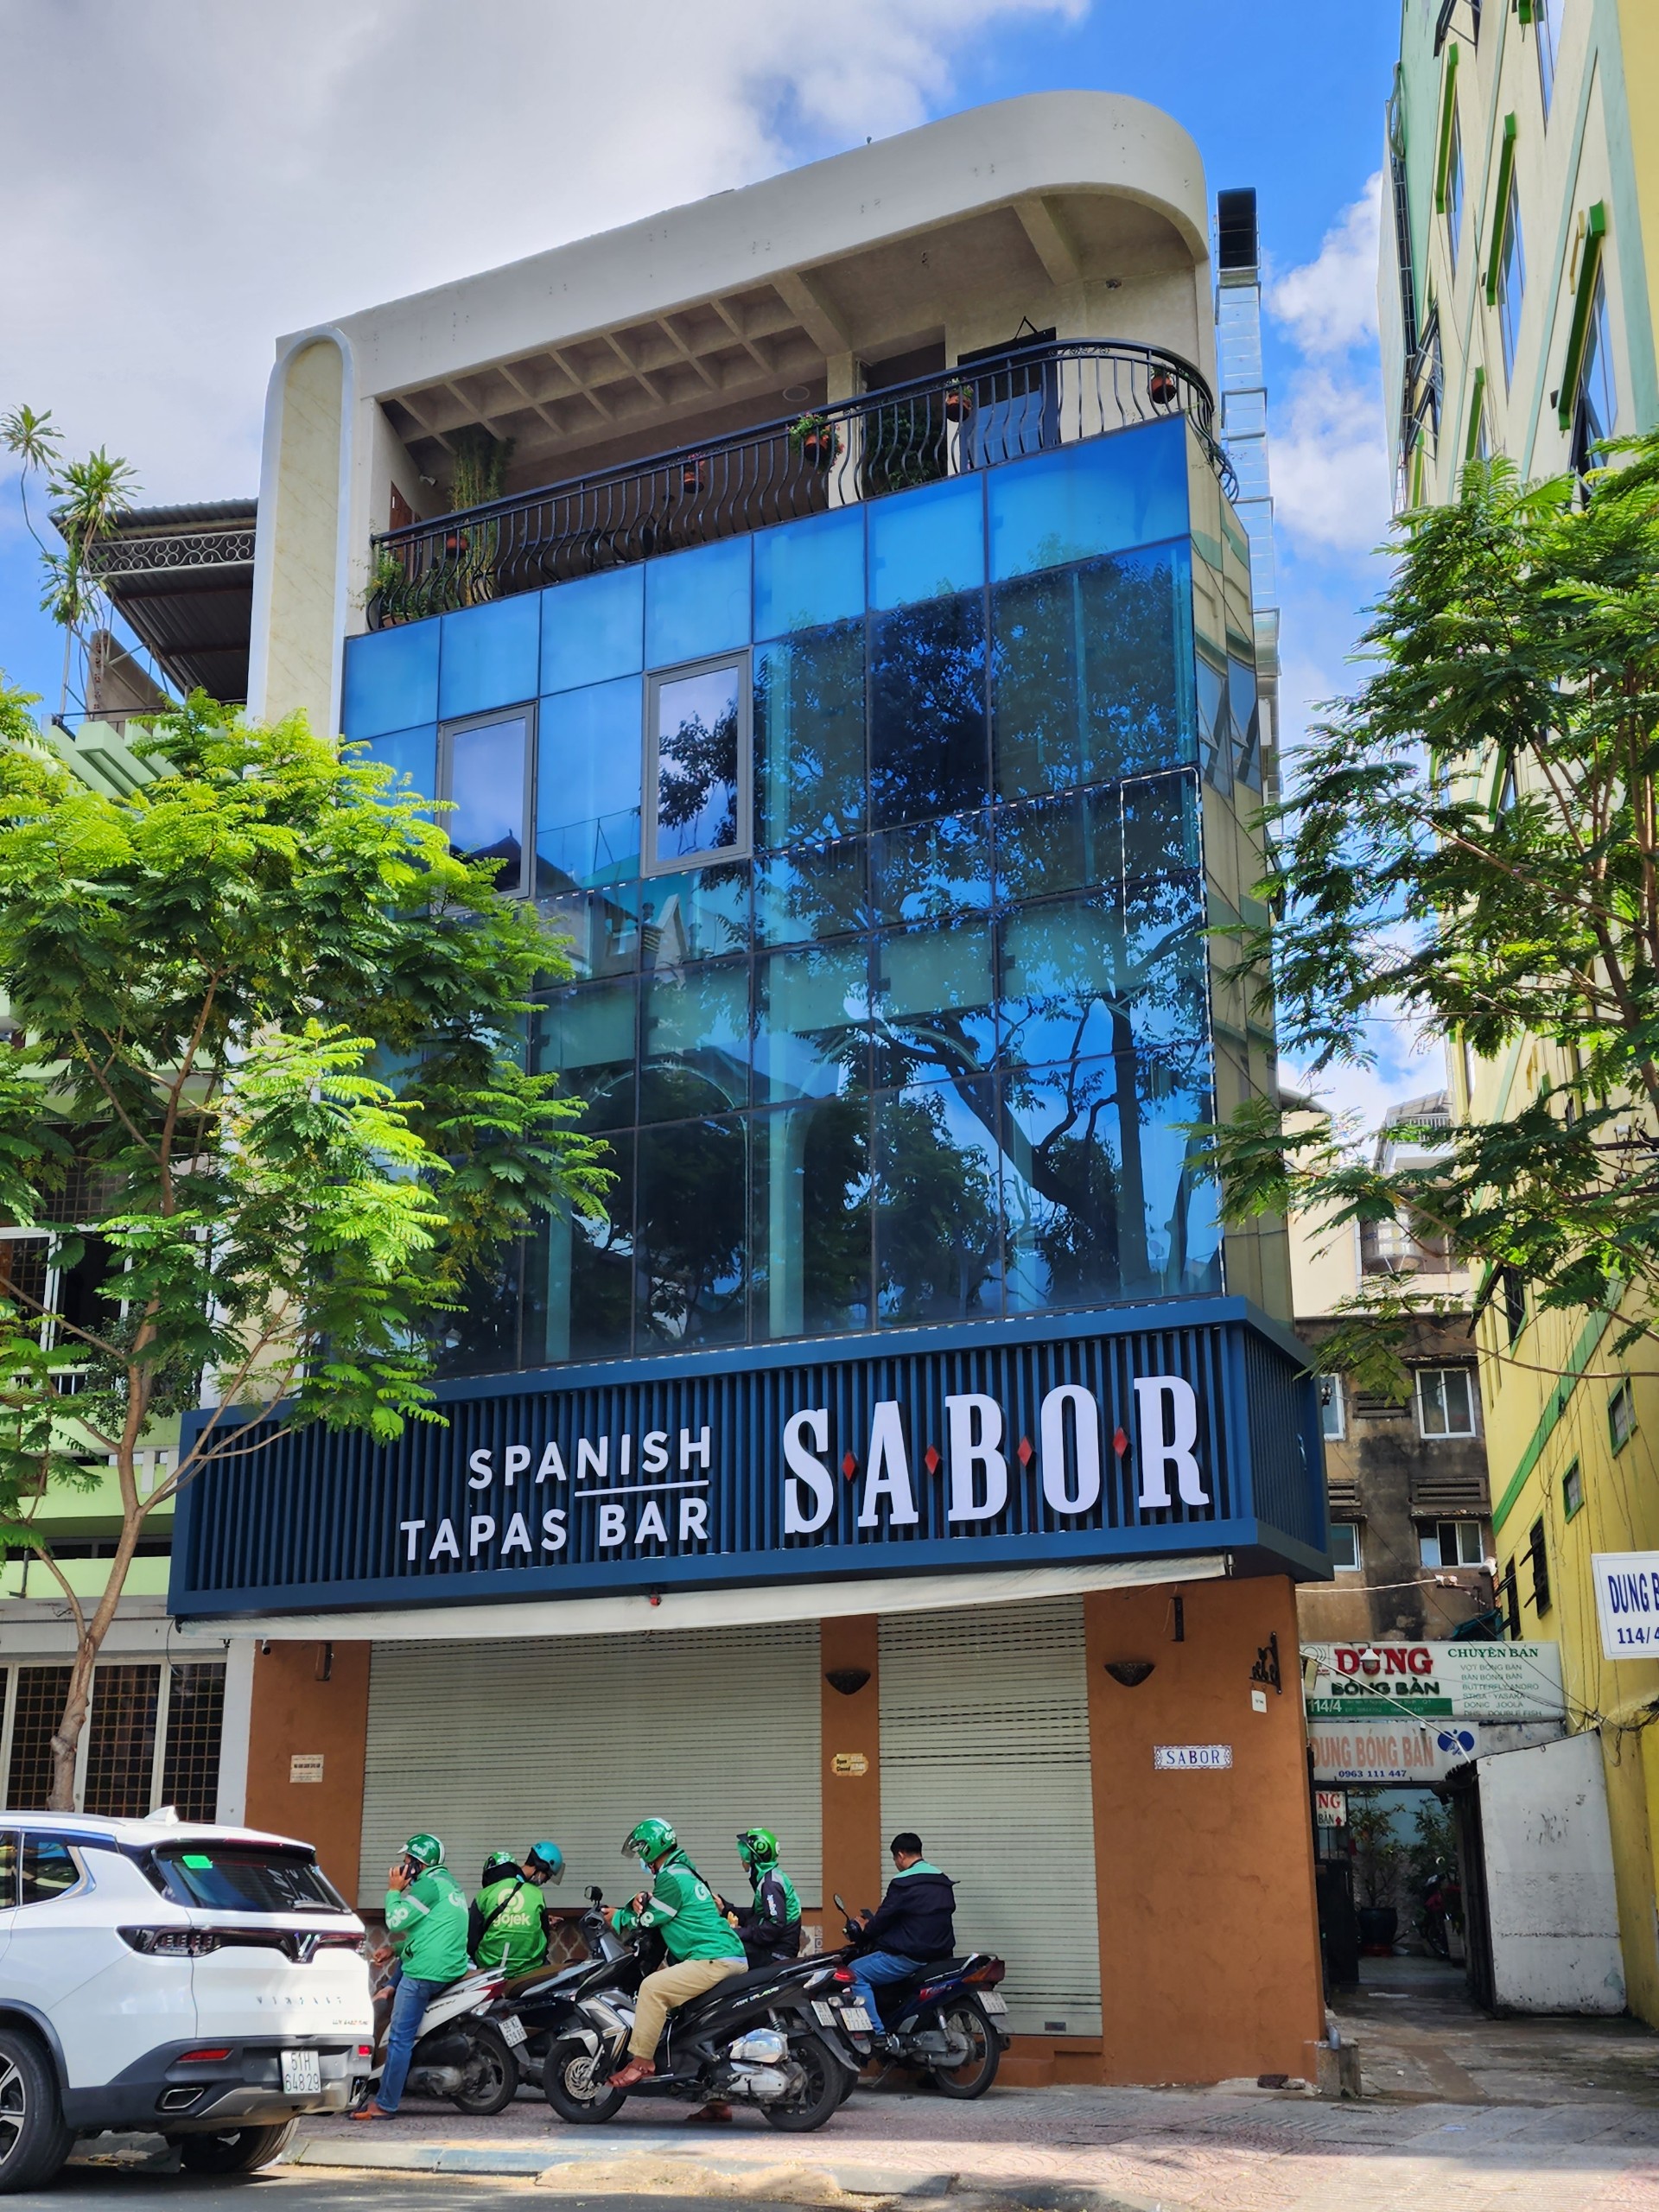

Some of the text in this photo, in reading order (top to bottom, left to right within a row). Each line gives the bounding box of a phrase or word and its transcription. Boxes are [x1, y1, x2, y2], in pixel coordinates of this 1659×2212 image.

[467, 1426, 711, 1491] SPANISH
[781, 1375, 1210, 1535] SABOR
[400, 1497, 709, 1561] TAPAS BAR
[1607, 1573, 1651, 1613] DUNG
[1447, 1644, 1539, 1658] CHUYÊN BÁN
[1395, 1676, 1440, 1695] BÀN
[1308, 1698, 1342, 1713] 114/4
[1166, 1749, 1220, 1765] SABOR
[1355, 1729, 1399, 1768] BÓNG
[1402, 1729, 1434, 1767] BÀN
[1338, 1770, 1363, 1778] 0963
[1318, 1810, 1334, 1825] BÀN
[291, 2052, 311, 2071] 51H
